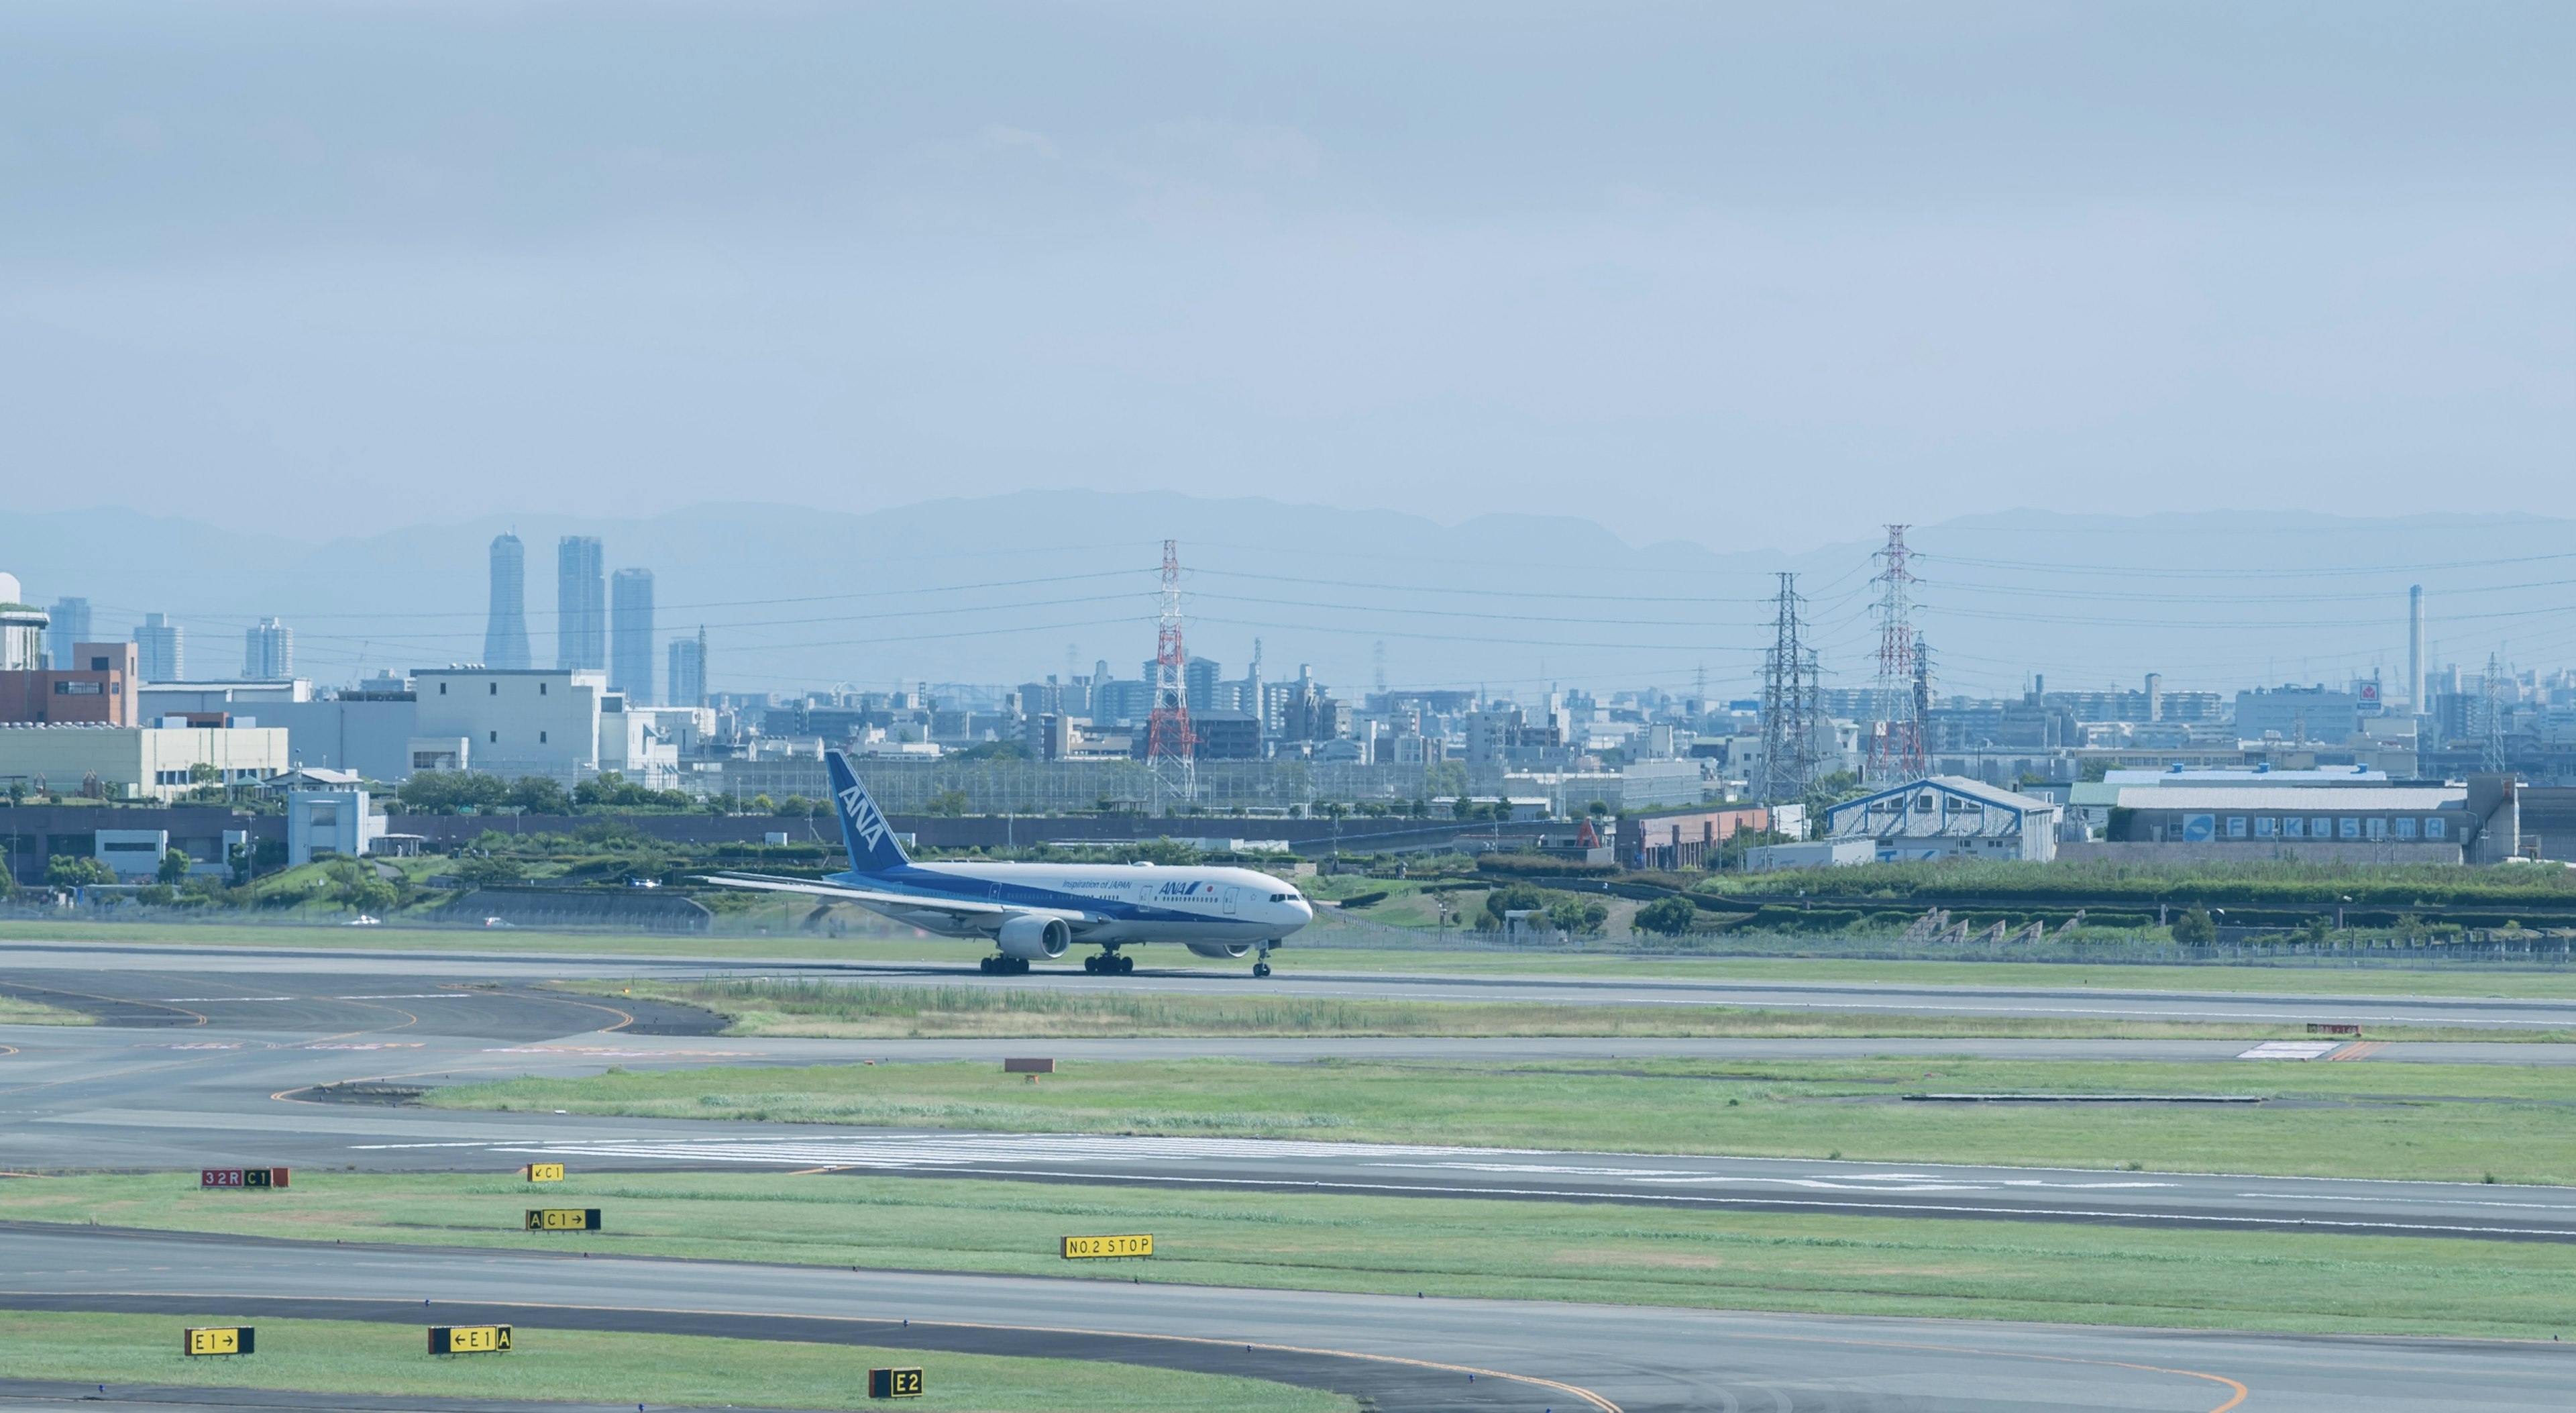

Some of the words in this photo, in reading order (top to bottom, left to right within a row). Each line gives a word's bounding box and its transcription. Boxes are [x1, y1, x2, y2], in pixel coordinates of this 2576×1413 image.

[838, 785, 884, 853] ANA
[1063, 880, 1099, 890] Inspiration
[1101, 880, 1110, 888] of
[1108, 880, 1132, 889] JAPAN
[1159, 882, 1187, 895] ANA
[205, 1171, 239, 1185] 32R
[248, 1171, 266, 1185] C1
[545, 1167, 559, 1178] C1
[530, 1213, 541, 1226] A
[547, 1213, 566, 1226] C1
[1108, 1239, 1148, 1253] STOP
[196, 1334, 215, 1349] E1
[471, 1331, 489, 1347] E1
[498, 1330, 510, 1347] A
[896, 1373, 918, 1392] E2
